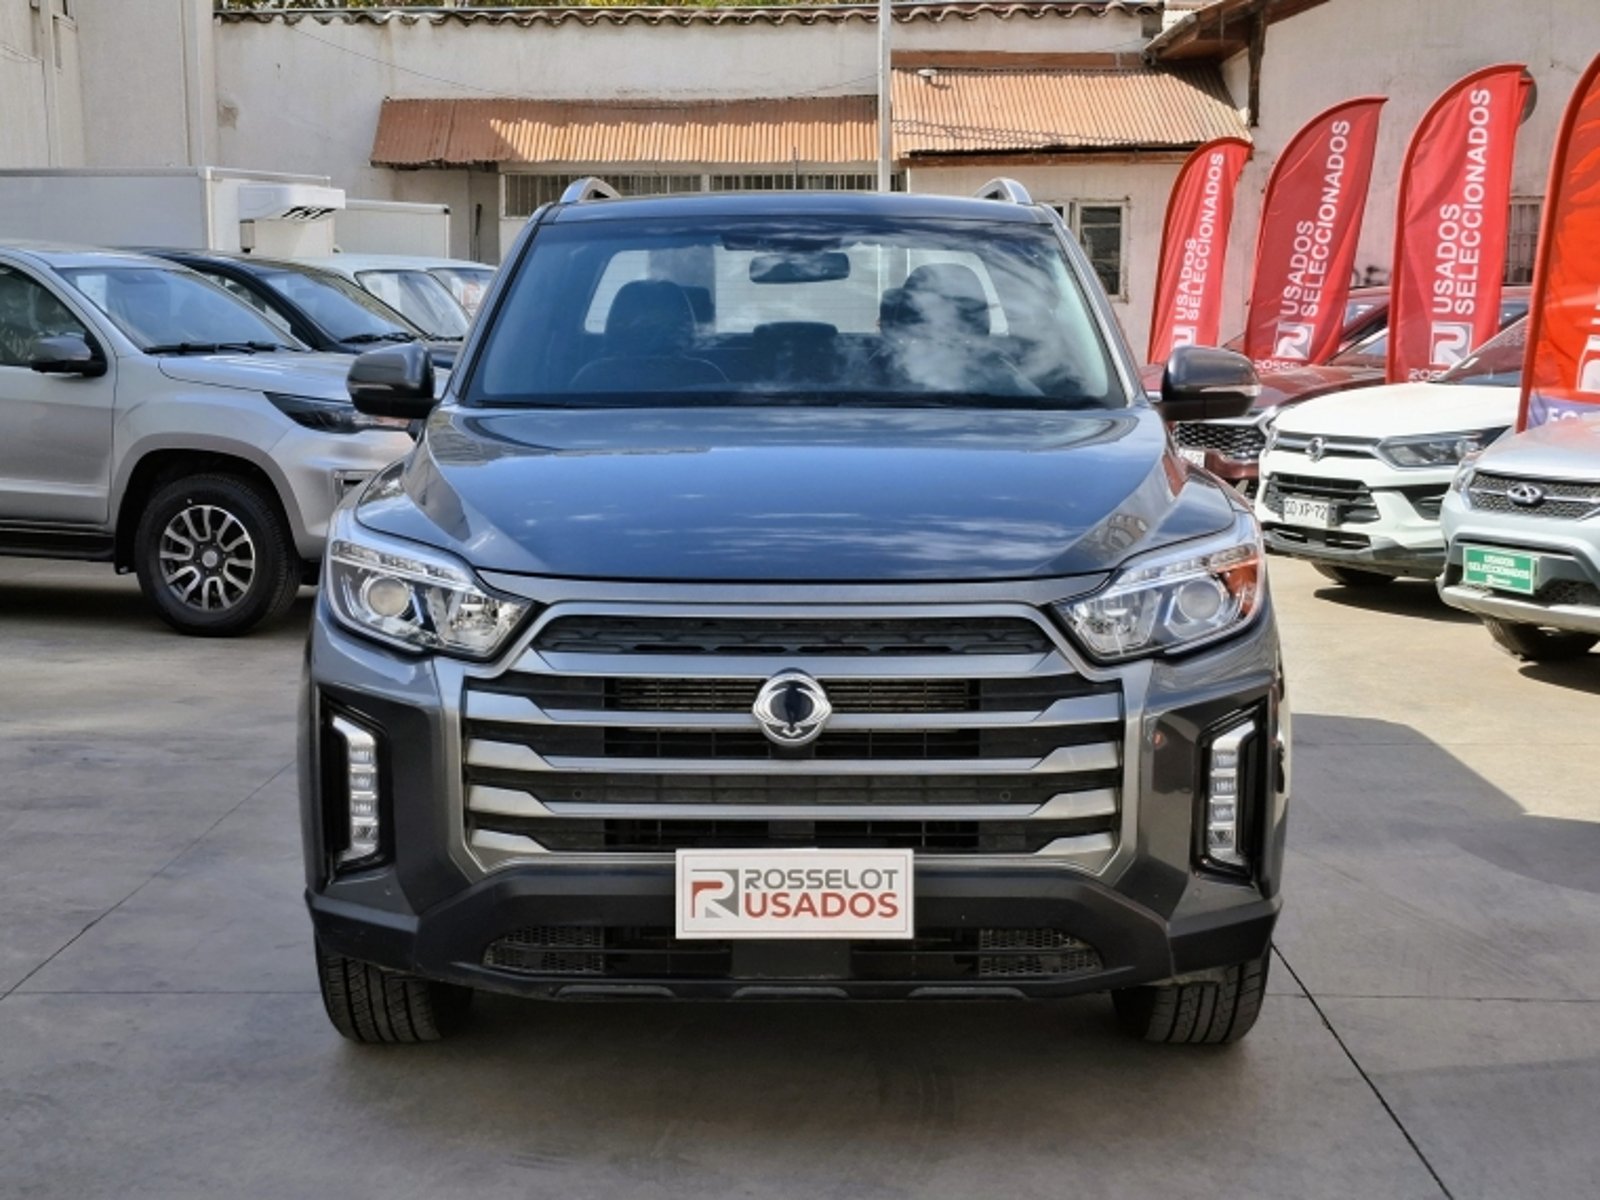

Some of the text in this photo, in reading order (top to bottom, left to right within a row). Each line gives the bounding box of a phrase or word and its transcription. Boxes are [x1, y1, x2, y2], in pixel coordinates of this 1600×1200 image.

[1186, 153, 1225, 321] SELECCIONADOS
[1301, 120, 1350, 317] SELECCIONADOS
[1454, 88, 1491, 316] SELECCIONADOS
[1174, 238, 1197, 320] USADOS
[1281, 220, 1314, 316] USADOS
[1433, 203, 1461, 315] USADOS
[745, 869, 898, 890] ROSSELOT
[745, 892, 898, 918] USADOS
